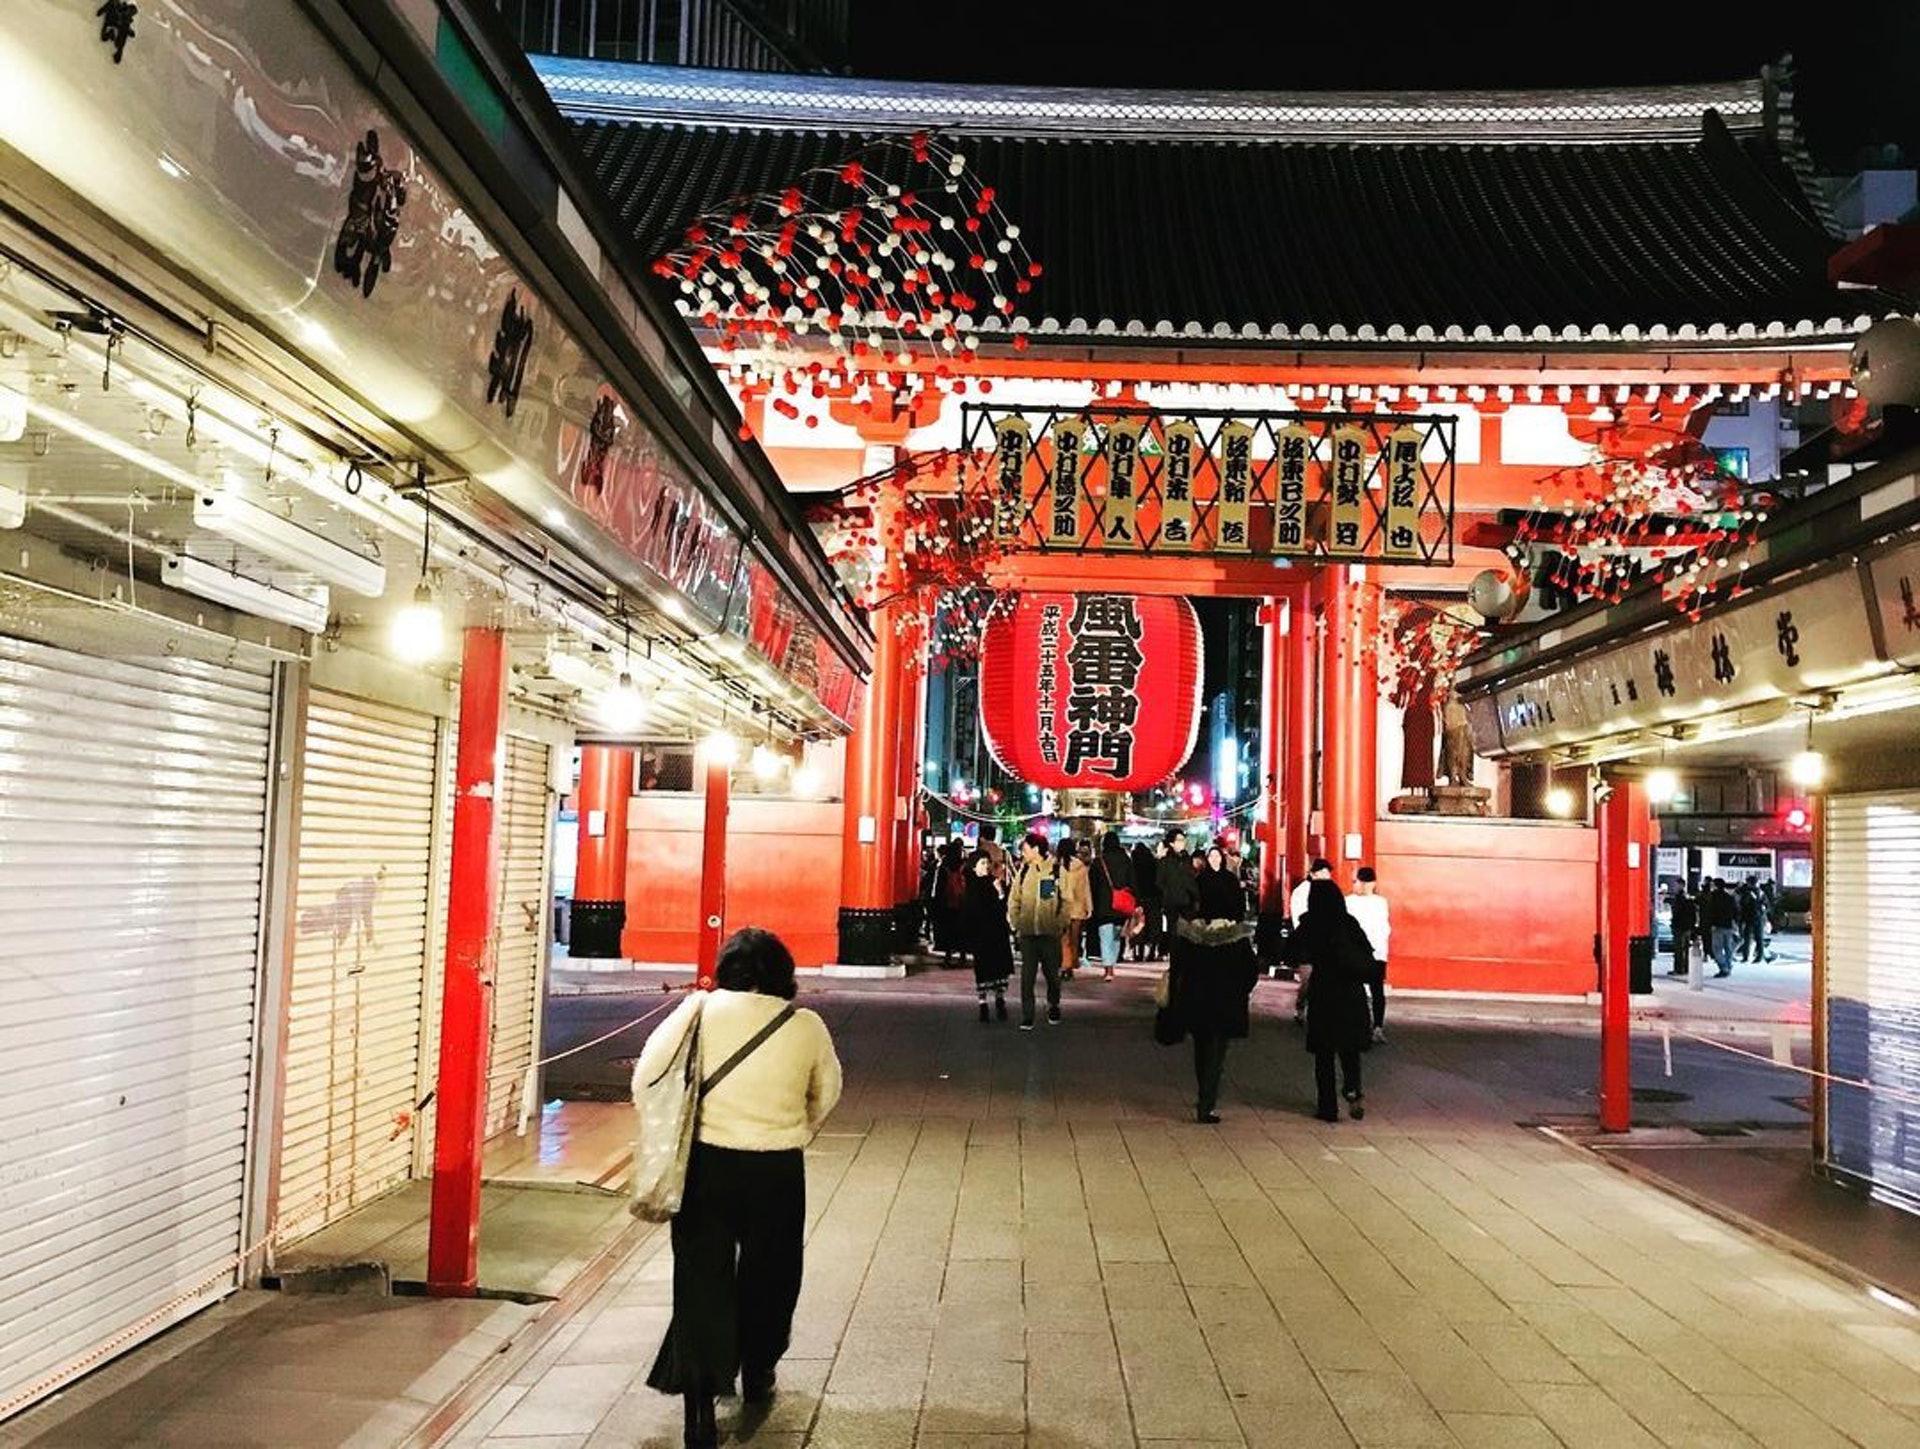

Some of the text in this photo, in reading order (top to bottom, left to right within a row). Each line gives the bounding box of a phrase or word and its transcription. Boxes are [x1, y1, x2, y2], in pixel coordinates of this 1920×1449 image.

[1037, 605, 1063, 764] 平成二十五年十一月吉日
[1064, 593, 1145, 780] 風雷神門
